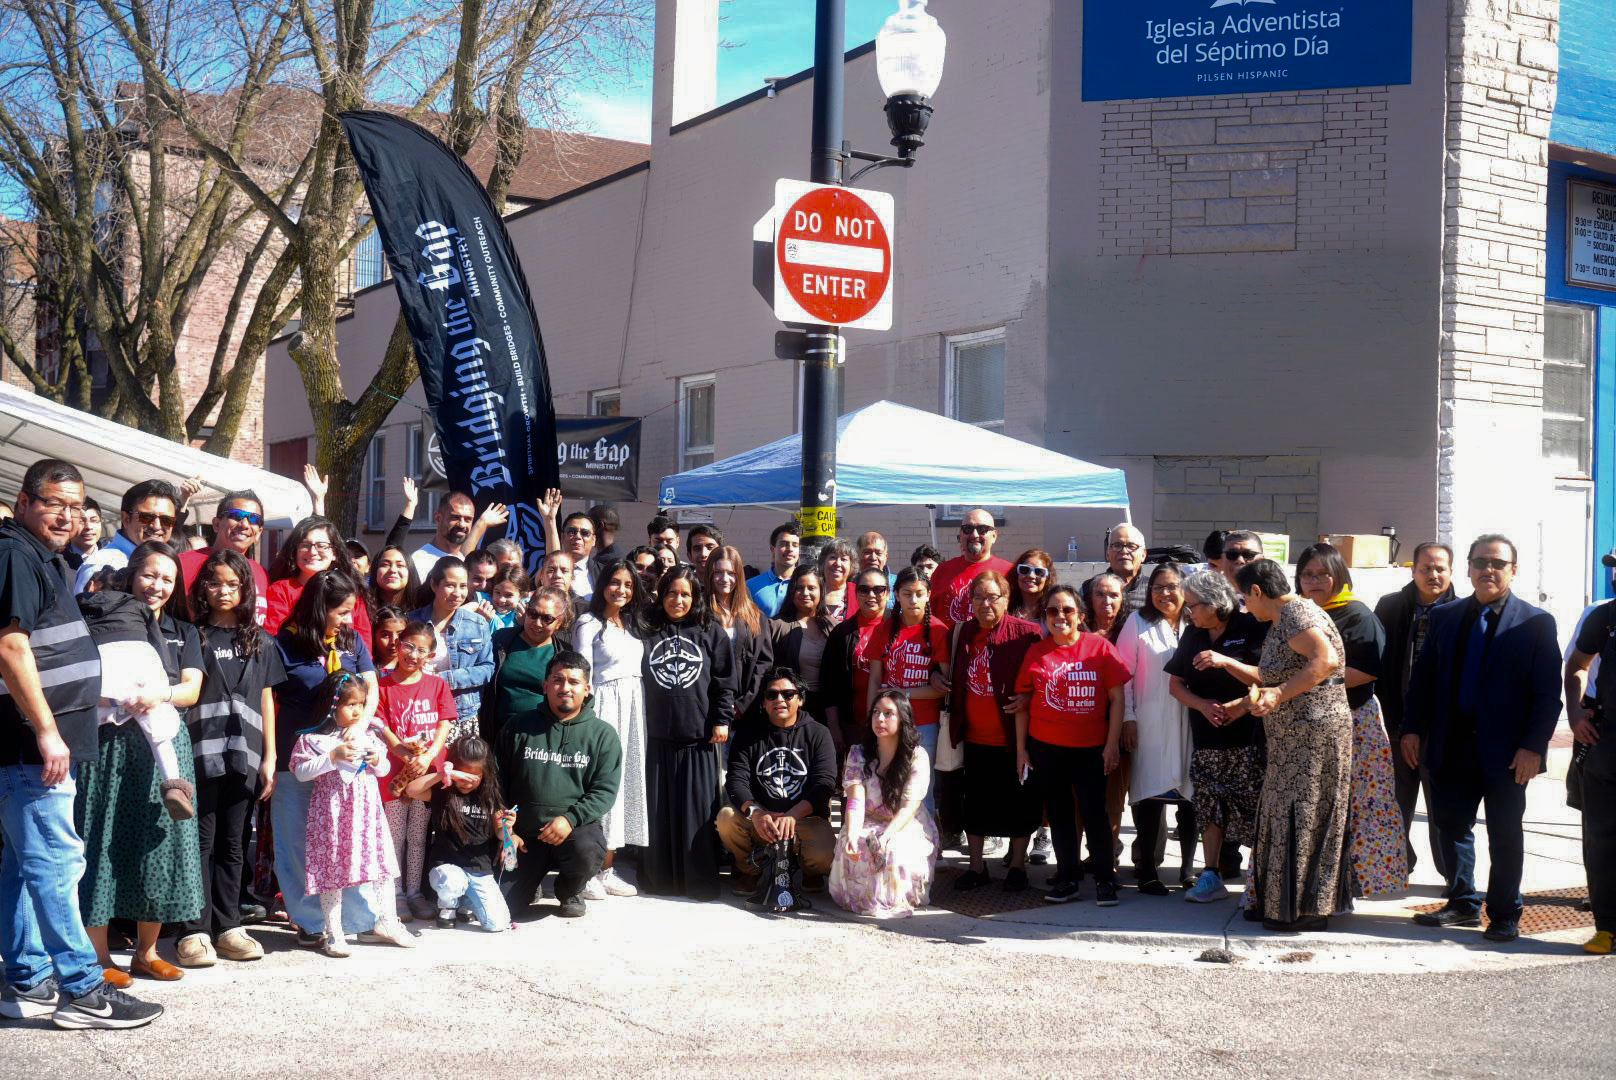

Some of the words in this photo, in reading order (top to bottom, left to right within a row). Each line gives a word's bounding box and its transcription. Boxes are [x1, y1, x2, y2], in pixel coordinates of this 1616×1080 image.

[1145, 17, 1215, 44] Iglesia
[1221, 9, 1341, 35] Adventista
[1156, 44, 1188, 65] del
[1195, 39, 1286, 66] Séptimo
[1294, 35, 1329, 56] Día
[1197, 72, 1233, 82] PILSEN
[1237, 69, 1288, 80] HISPANIC
[473, 216, 492, 263] OUTREACH
[795, 210, 822, 233] DO
[835, 216, 875, 240] NOT
[415, 220, 462, 292] Gap
[455, 236, 481, 298] MINISTRY
[1593, 253, 1616, 267] MIERCO
[486, 263, 507, 319] COMMUNITY
[802, 273, 866, 299] ENTER
[442, 297, 473, 336] the
[503, 325, 519, 361] BRIDGES
[513, 361, 525, 387] BUILD
[449, 337, 514, 497] Bridging
[520, 393, 530, 432] GROWTH
[570, 442, 590, 460] the
[593, 436, 630, 467] Gap
[523, 746, 562, 765] Bridging
[573, 750, 591, 767] Gap
